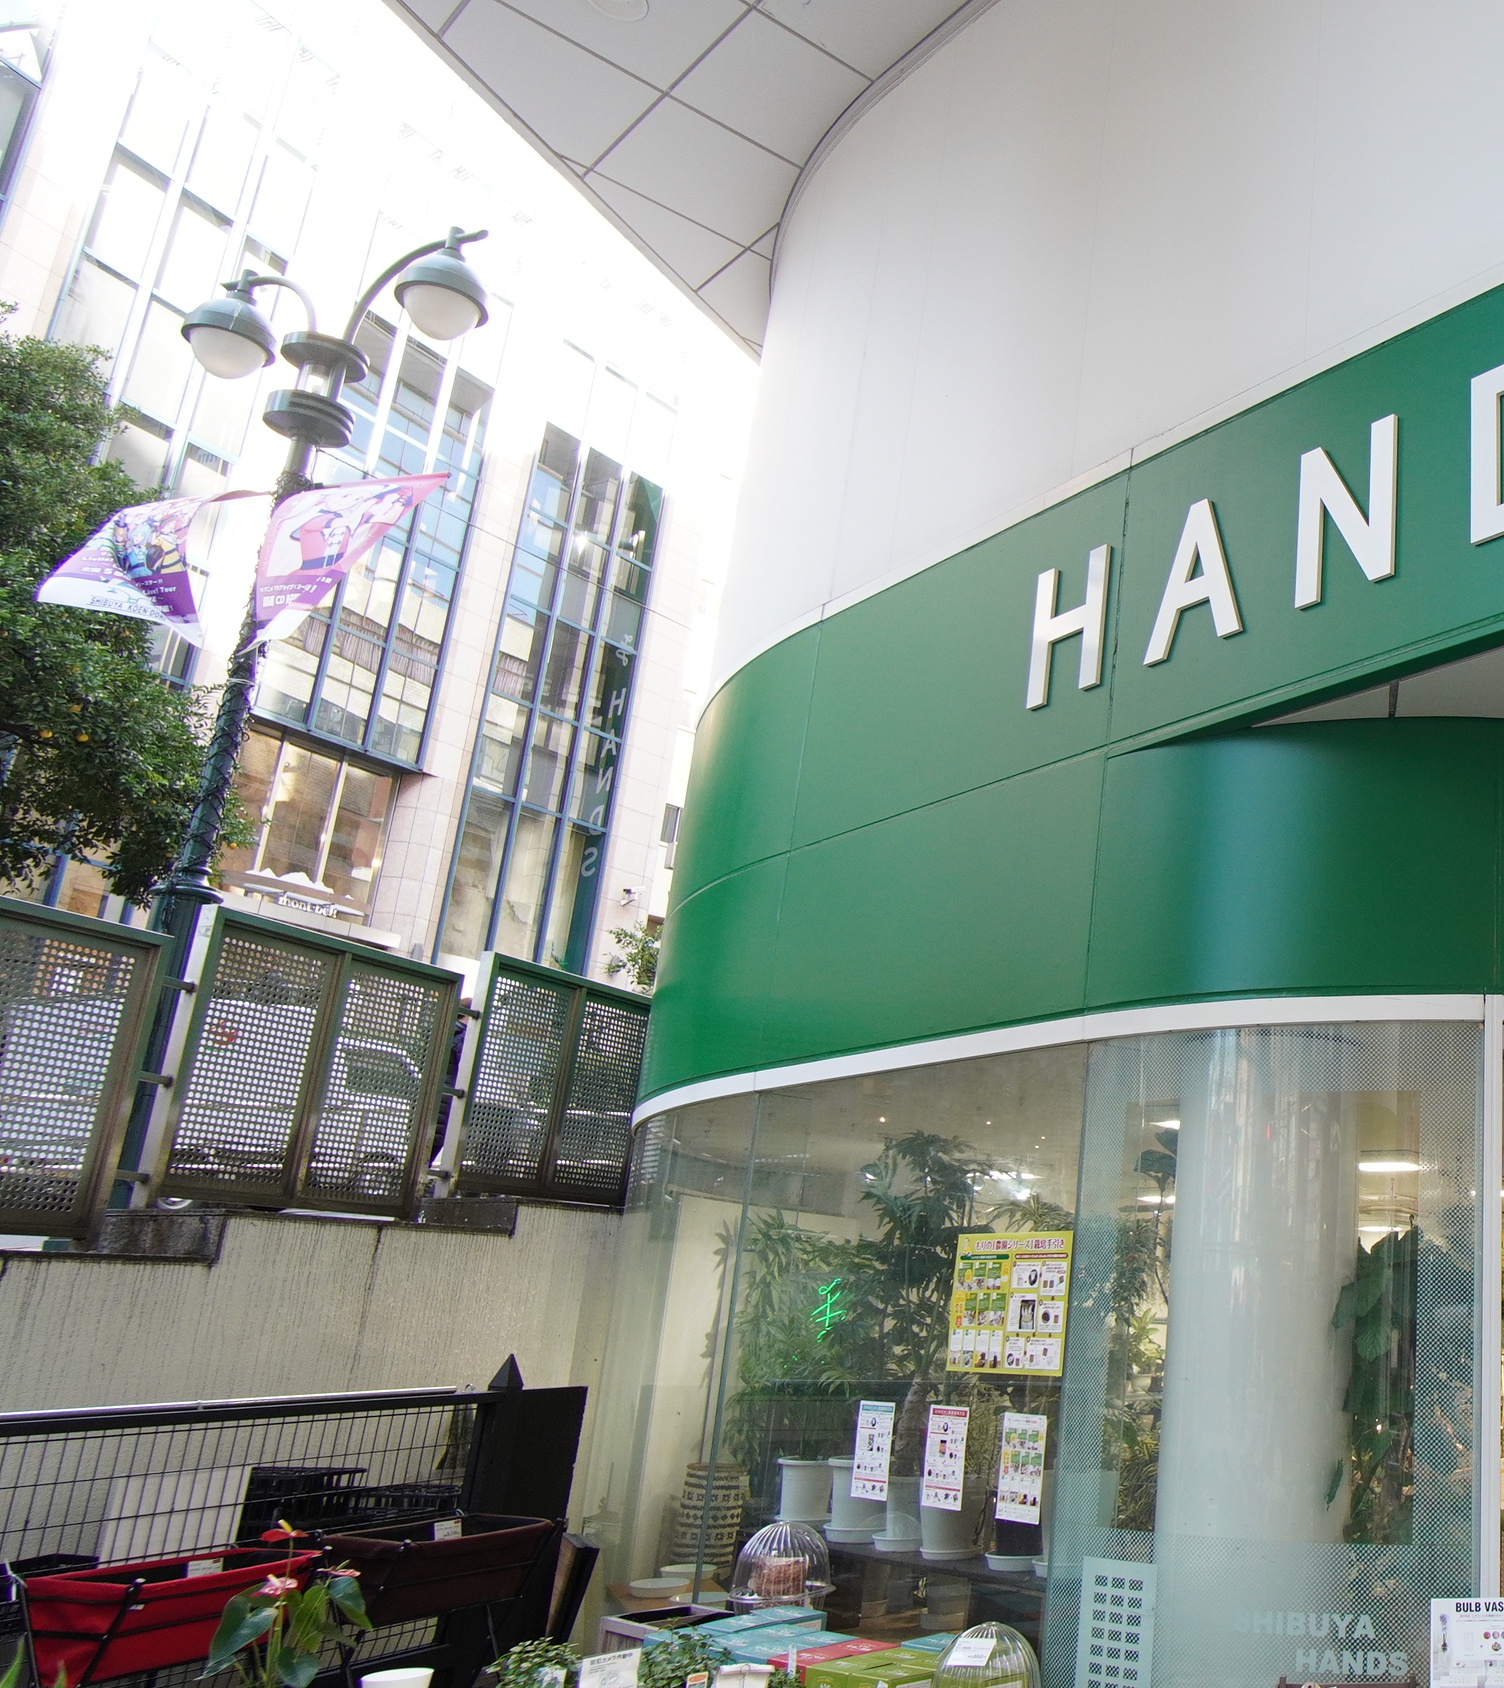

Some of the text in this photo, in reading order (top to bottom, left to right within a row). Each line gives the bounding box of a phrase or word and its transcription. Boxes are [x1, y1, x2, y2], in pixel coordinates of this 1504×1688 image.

[90, 596, 124, 610] SHIBUYA
[1455, 1601, 1482, 1612] BULB
[1295, 1648, 1409, 1676] HANDS
